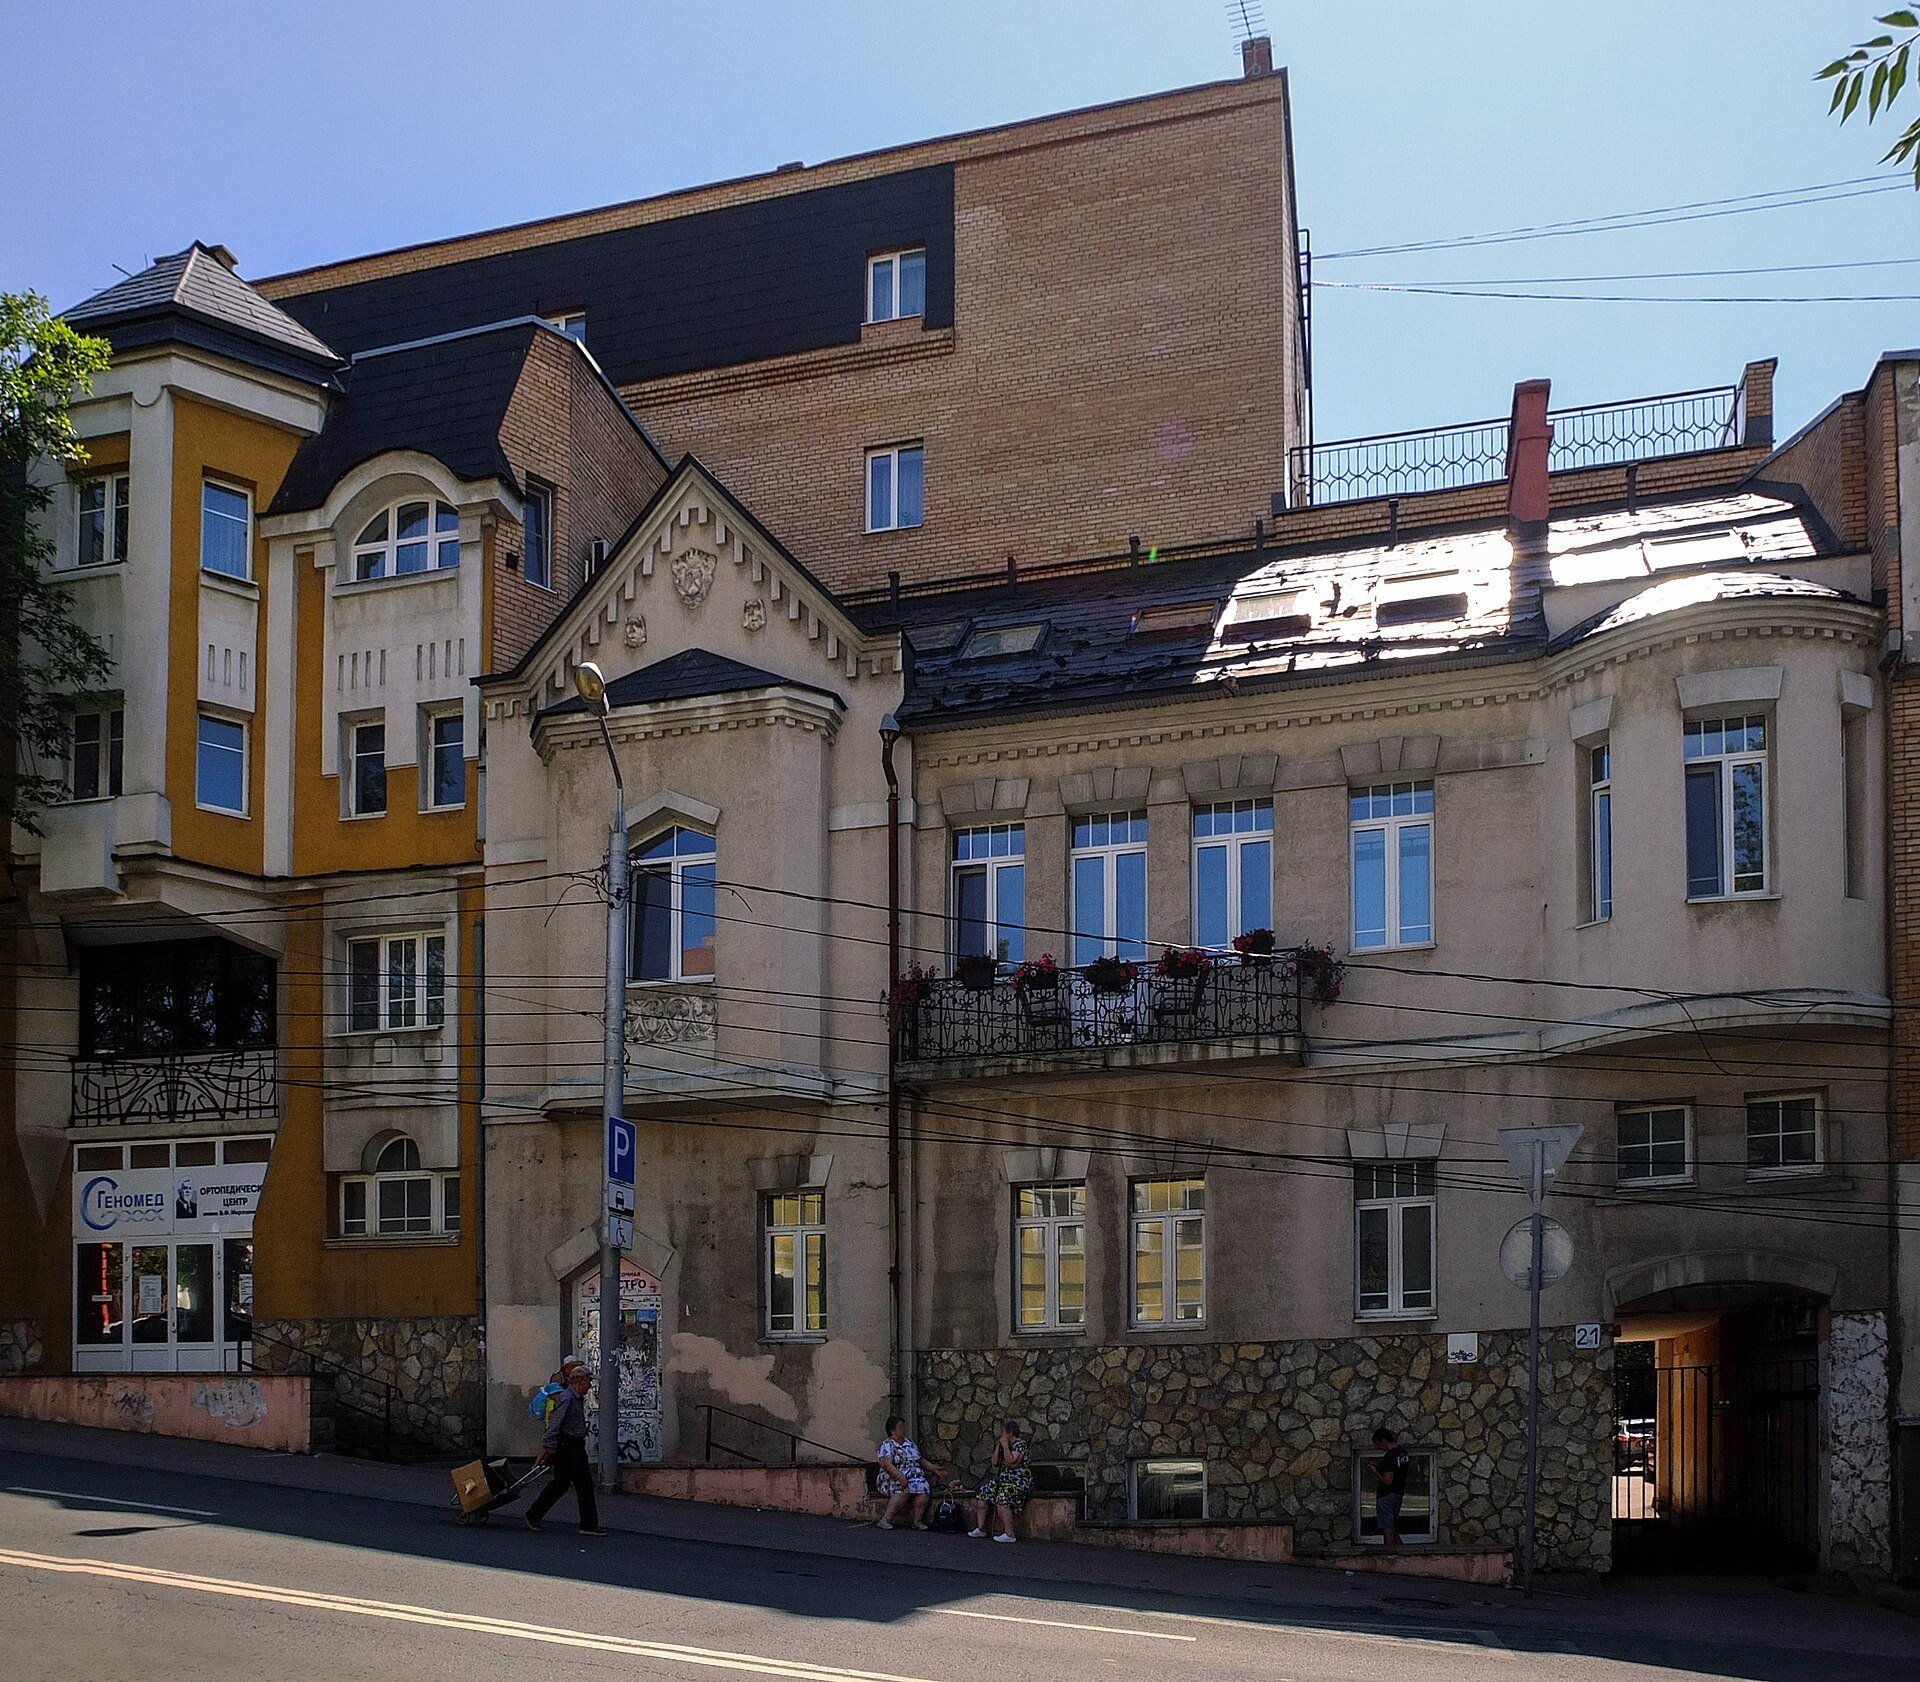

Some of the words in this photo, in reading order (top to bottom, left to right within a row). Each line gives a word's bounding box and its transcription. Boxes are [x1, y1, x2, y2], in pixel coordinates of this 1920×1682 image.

[614, 1125, 630, 1173] P
[223, 1197, 248, 1207] ЦЕНТР
[1576, 1327, 1599, 1345] 21
